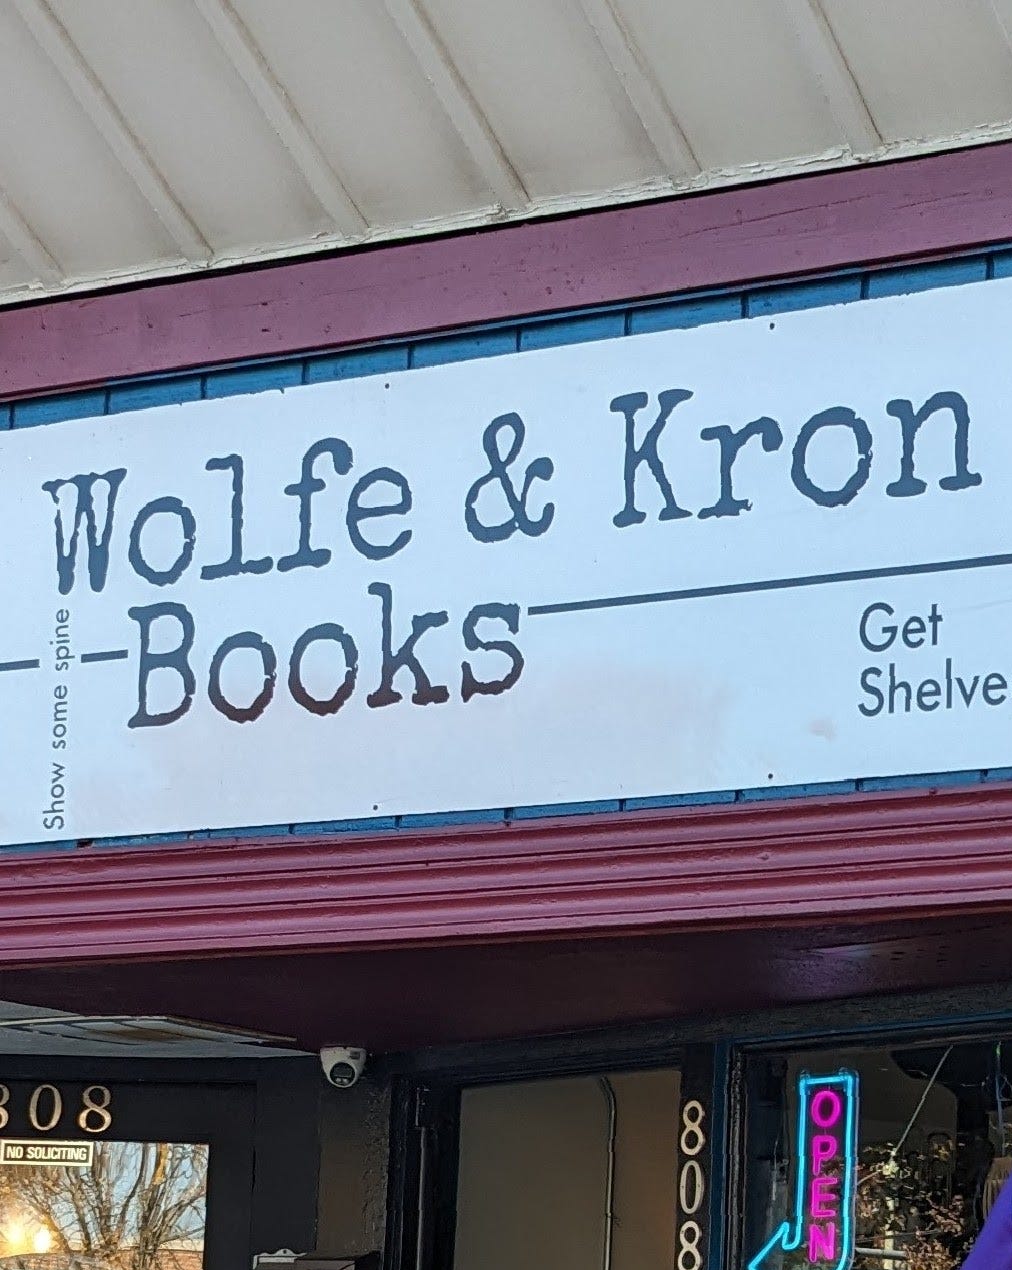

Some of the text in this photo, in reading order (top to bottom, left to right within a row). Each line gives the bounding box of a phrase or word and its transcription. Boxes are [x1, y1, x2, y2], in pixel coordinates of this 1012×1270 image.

[42, 388, 982, 595] Wolfe & Kron
[127, 582, 525, 728] Books
[858, 602, 943, 652] Get
[42, 608, 76, 830] Show some spine
[6, 1146, 88, 1161] NO SOLICITING
[808, 1090, 842, 1263] OPEN
